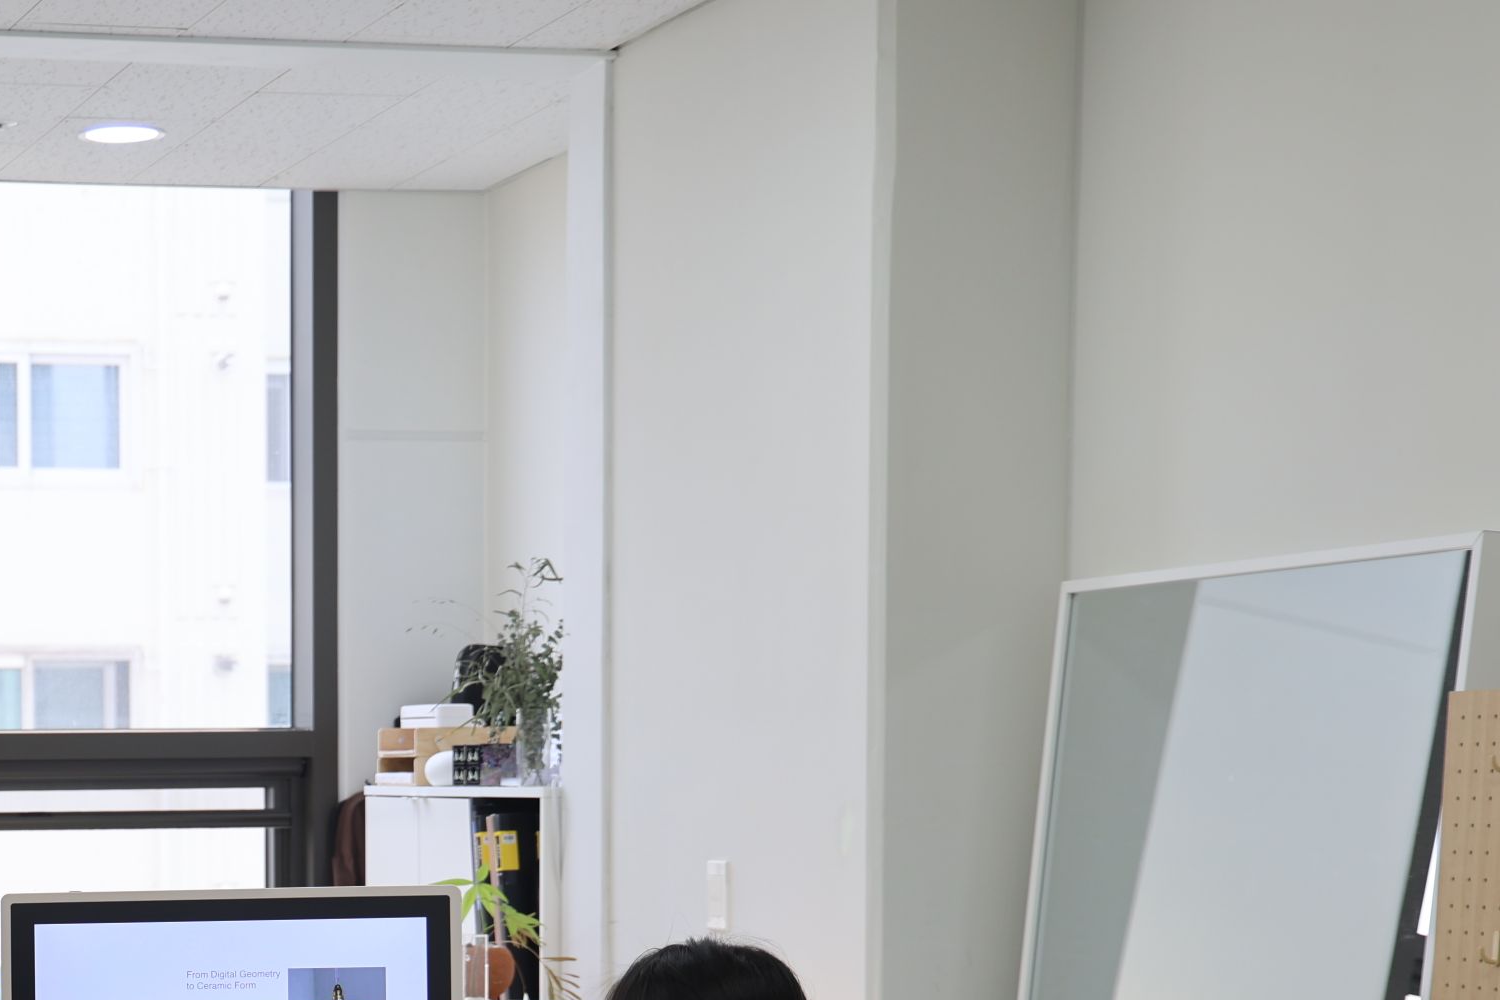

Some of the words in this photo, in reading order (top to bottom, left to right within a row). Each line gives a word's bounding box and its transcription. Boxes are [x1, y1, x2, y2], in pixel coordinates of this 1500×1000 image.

[186, 970, 208, 979] From
[211, 970, 237, 979] Digital
[239, 970, 280, 979] Geometry
[197, 982, 232, 990] Ceramic
[234, 981, 256, 989] Form
